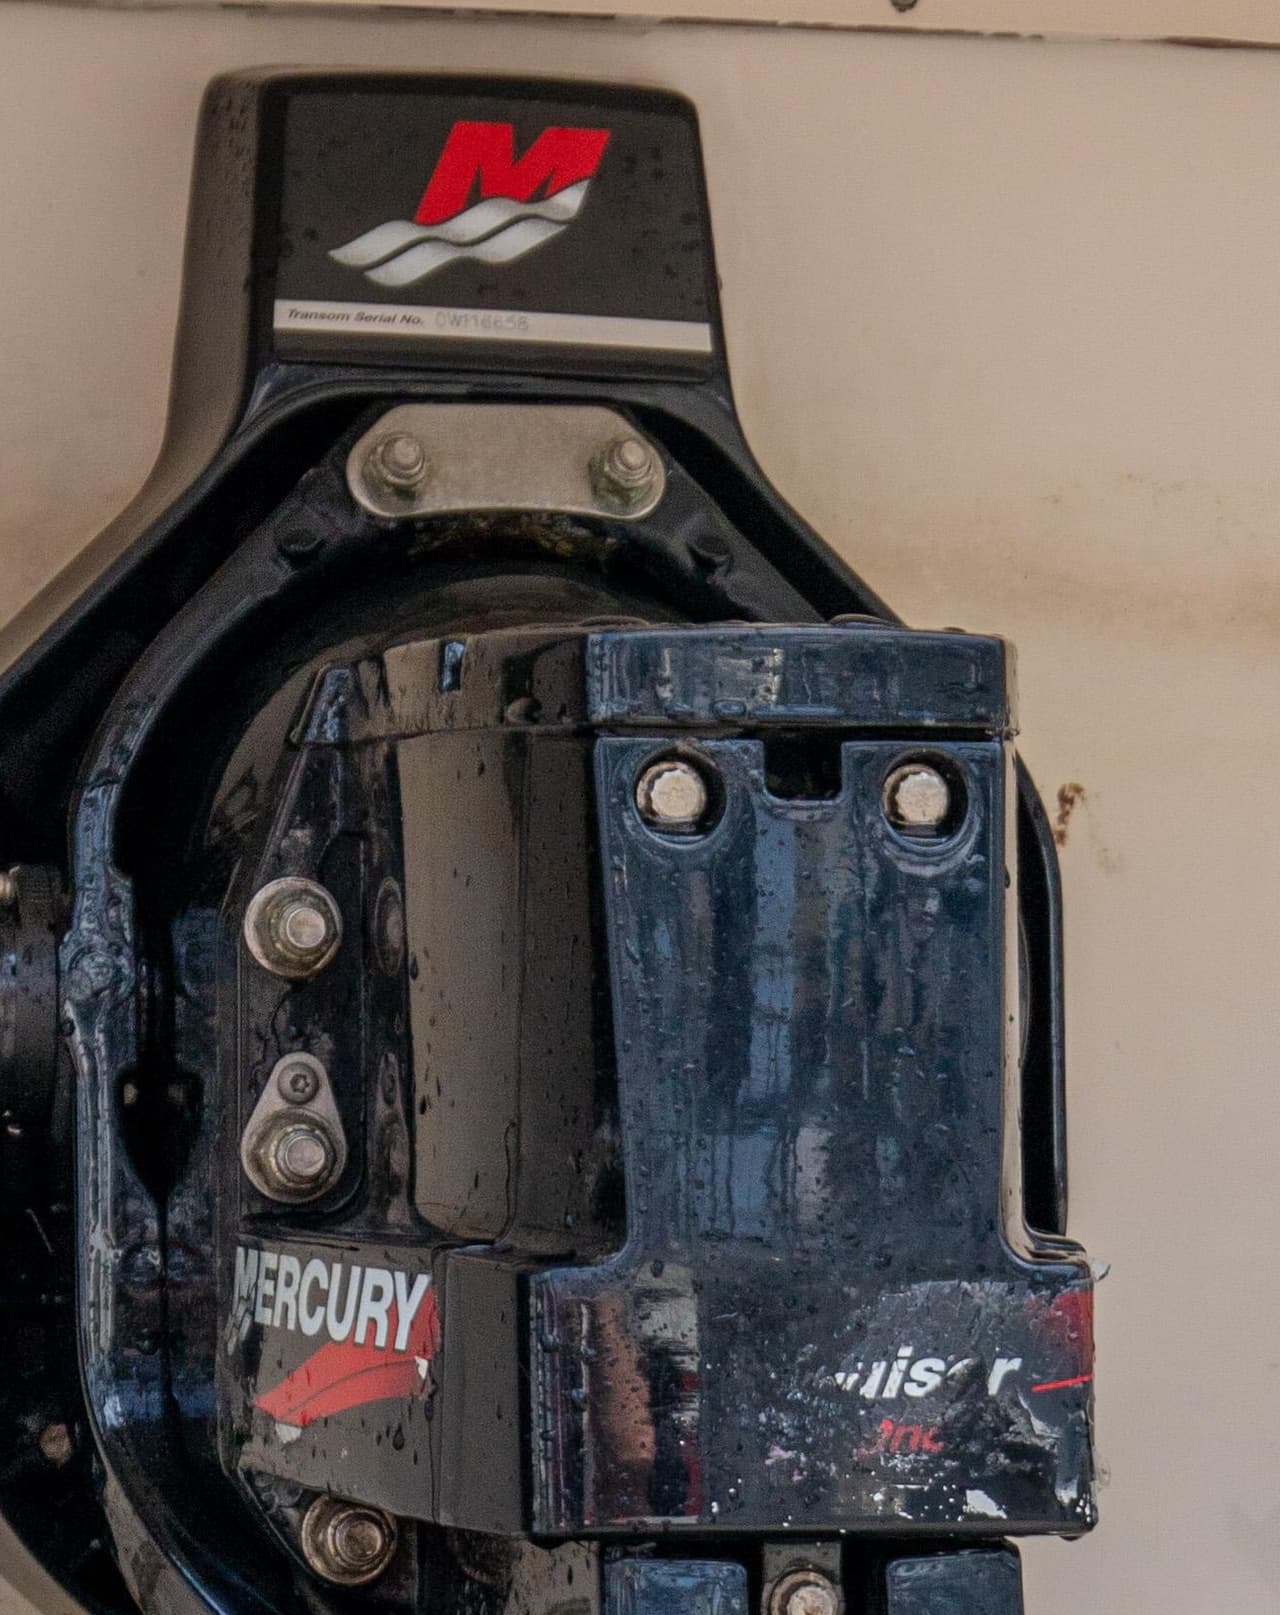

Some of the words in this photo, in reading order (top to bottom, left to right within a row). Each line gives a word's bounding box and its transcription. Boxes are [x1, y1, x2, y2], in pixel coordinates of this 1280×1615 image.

[287, 307, 350, 323] Transom
[353, 311, 396, 325] Serial
[399, 312, 425, 327] No.
[232, 1245, 432, 1352] MERCURY
